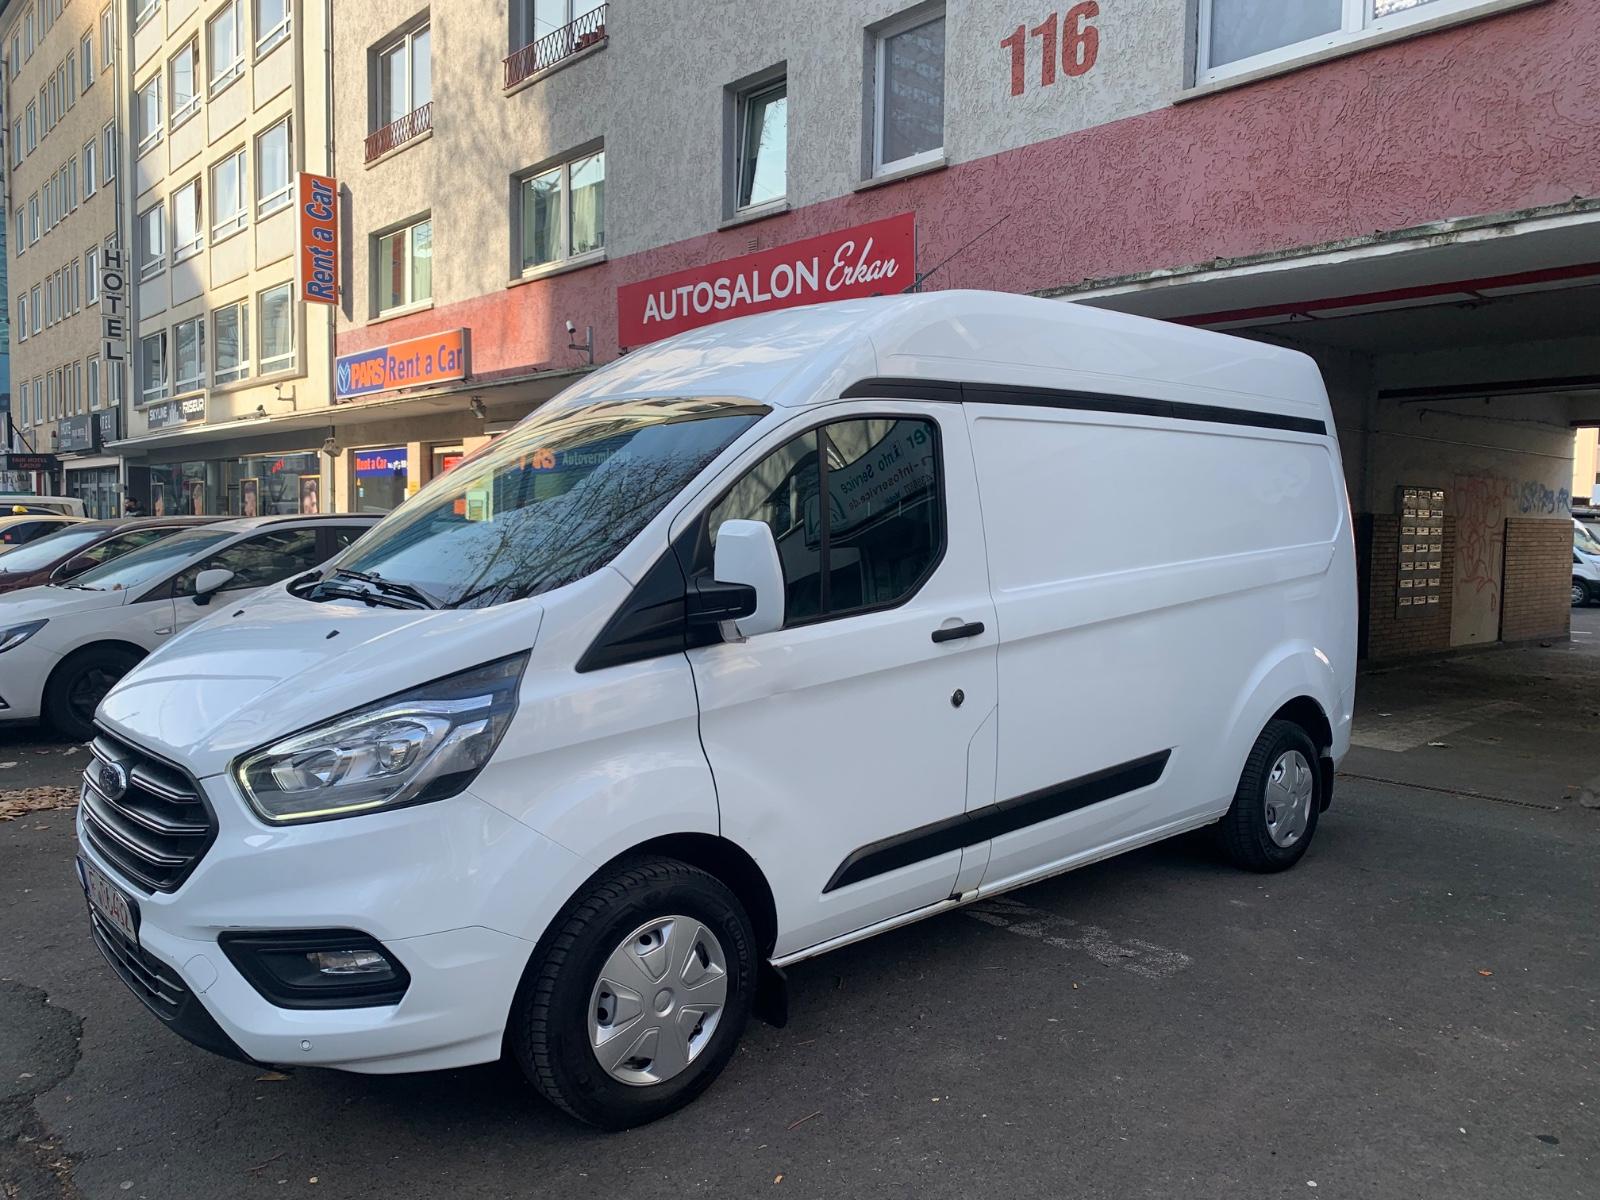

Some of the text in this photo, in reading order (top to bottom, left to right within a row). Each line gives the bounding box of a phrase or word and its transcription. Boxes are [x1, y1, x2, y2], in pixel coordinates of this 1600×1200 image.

[1000, 0, 1100, 97] 116
[305, 179, 334, 300] Rent a Car
[643, 237, 899, 324] AUTOSALON Erkan
[104, 249, 123, 360] HOTEL
[183, 398, 204, 414] FRISEUR
[351, 344, 463, 389] PARS Rent a Car
